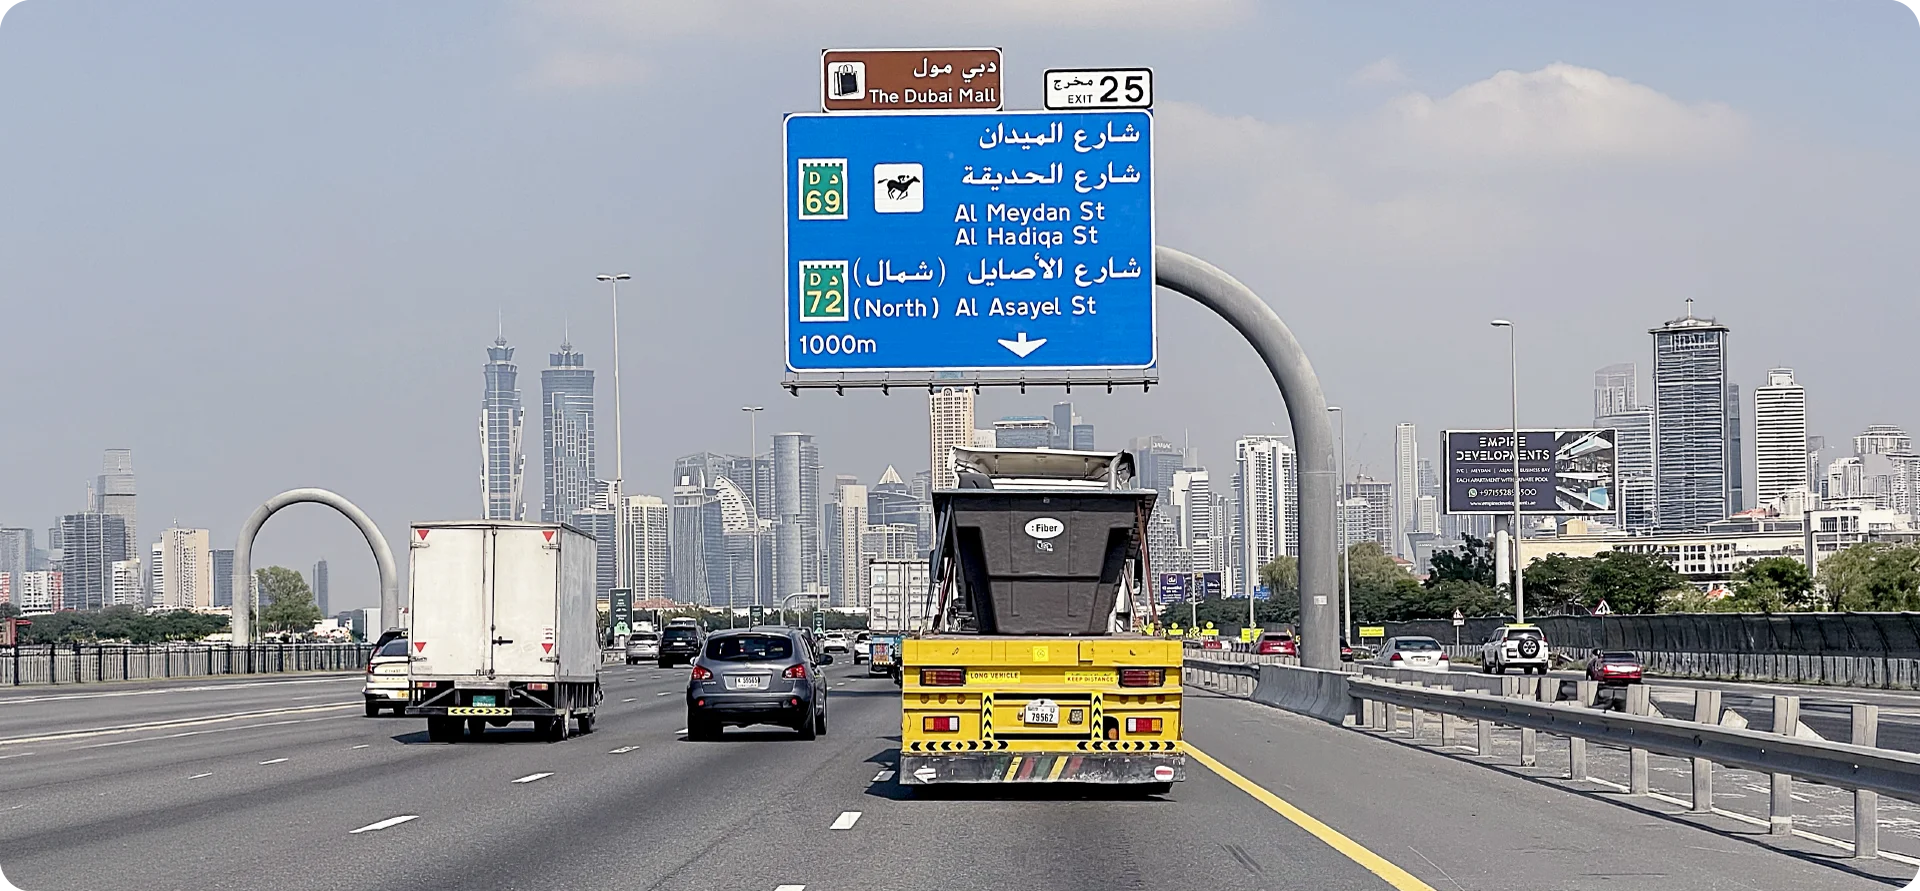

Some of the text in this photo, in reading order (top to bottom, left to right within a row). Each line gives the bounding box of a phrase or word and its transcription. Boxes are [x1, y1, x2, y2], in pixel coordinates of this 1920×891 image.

[913, 58, 997, 83] دبي مول
[869, 87, 997, 104] The Dubai Mall
[1053, 80, 1094, 90] مخرج
[1100, 75, 1144, 103] 25
[1067, 94, 1093, 104] EXIT
[979, 121, 1140, 152] شارع الميدان
[809, 171, 821, 185] D
[962, 161, 1141, 193] شارع الحديقة
[806, 190, 840, 213] 69
[954, 202, 1105, 226] Al Meydan St
[954, 226, 1099, 248] Al Hadiqa St
[810, 272, 822, 286] D
[967, 253, 1063, 287] الأصايل
[1074, 256, 1141, 287] شارع
[806, 291, 842, 313] 72
[853, 296, 1097, 320] (North) Al Asayel St
[799, 335, 877, 354] 1000m
[1035, 523, 1058, 533] Fiber
[1031, 712, 1054, 722] 79562
